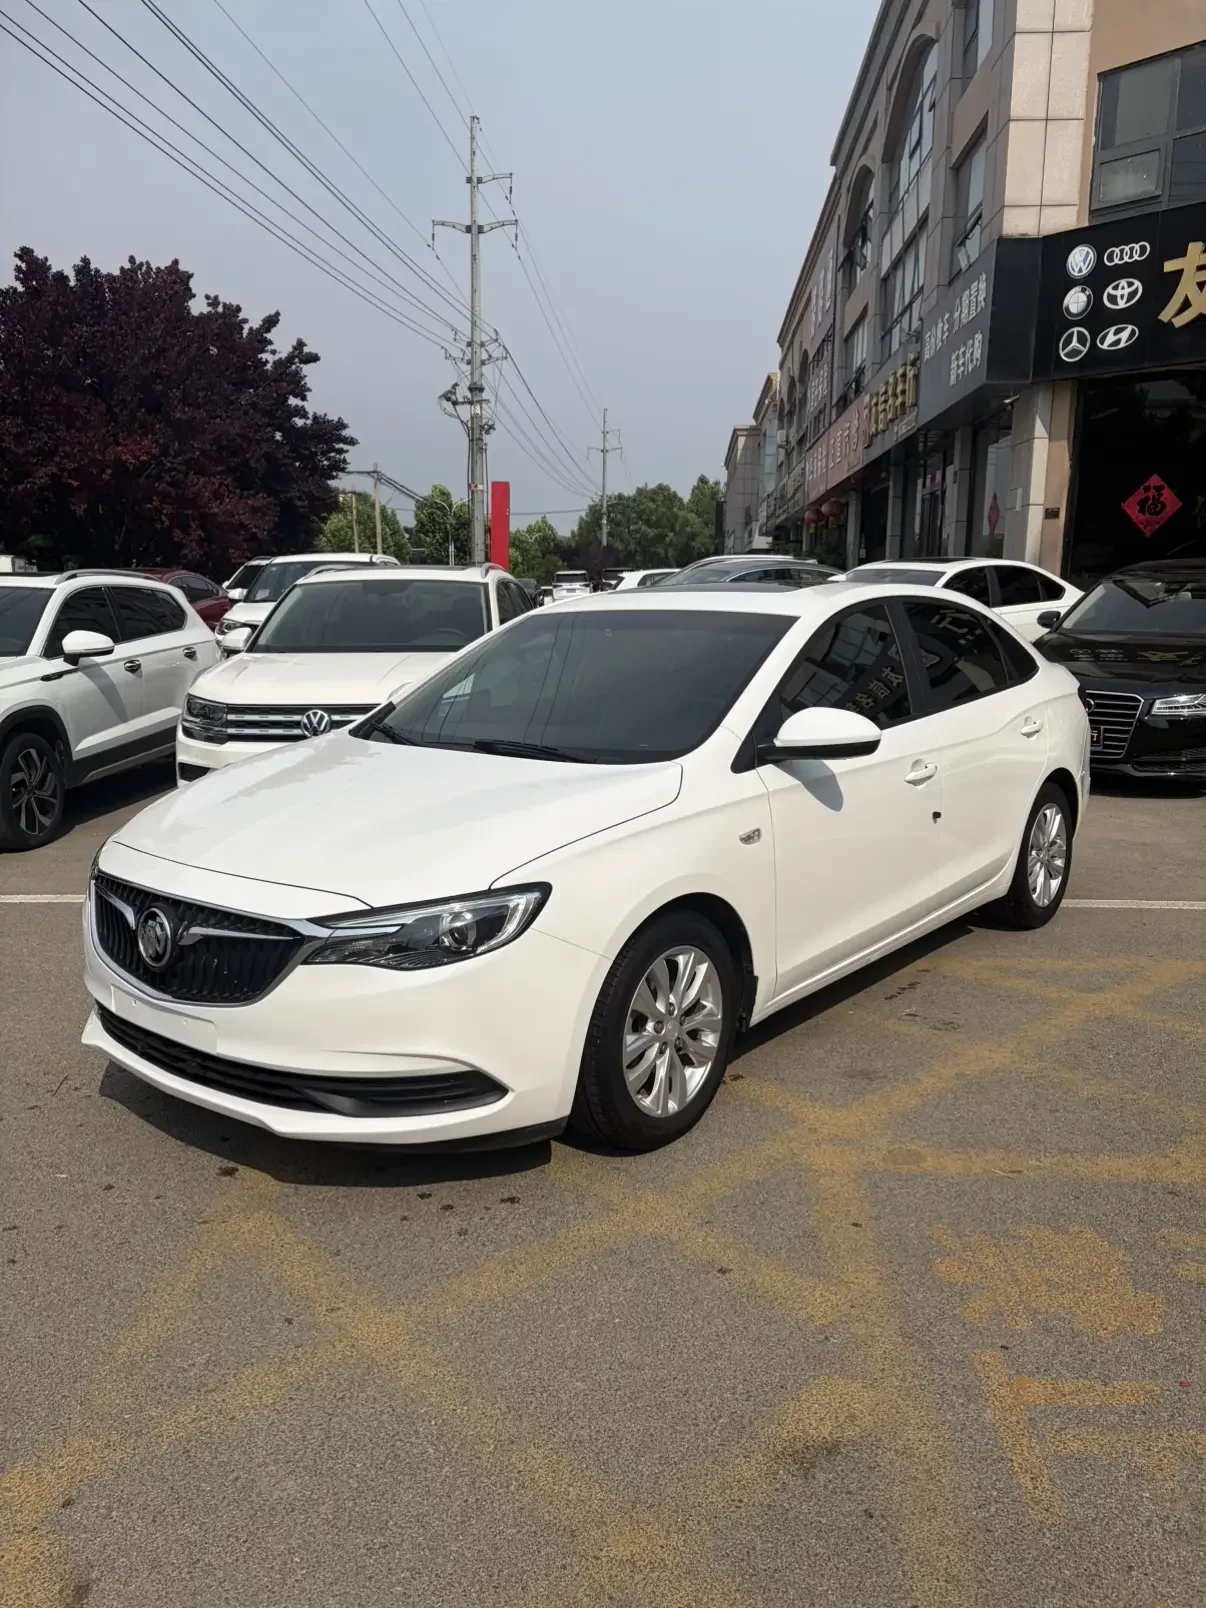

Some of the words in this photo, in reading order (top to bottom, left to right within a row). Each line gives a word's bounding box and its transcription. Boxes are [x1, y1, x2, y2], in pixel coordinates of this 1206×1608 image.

[923, 310, 951, 363] 高价收车
[952, 272, 988, 335] 分期置换
[1157, 241, 1206, 328] 友
[949, 329, 984, 387] 新车代购
[1136, 484, 1167, 517] 福
